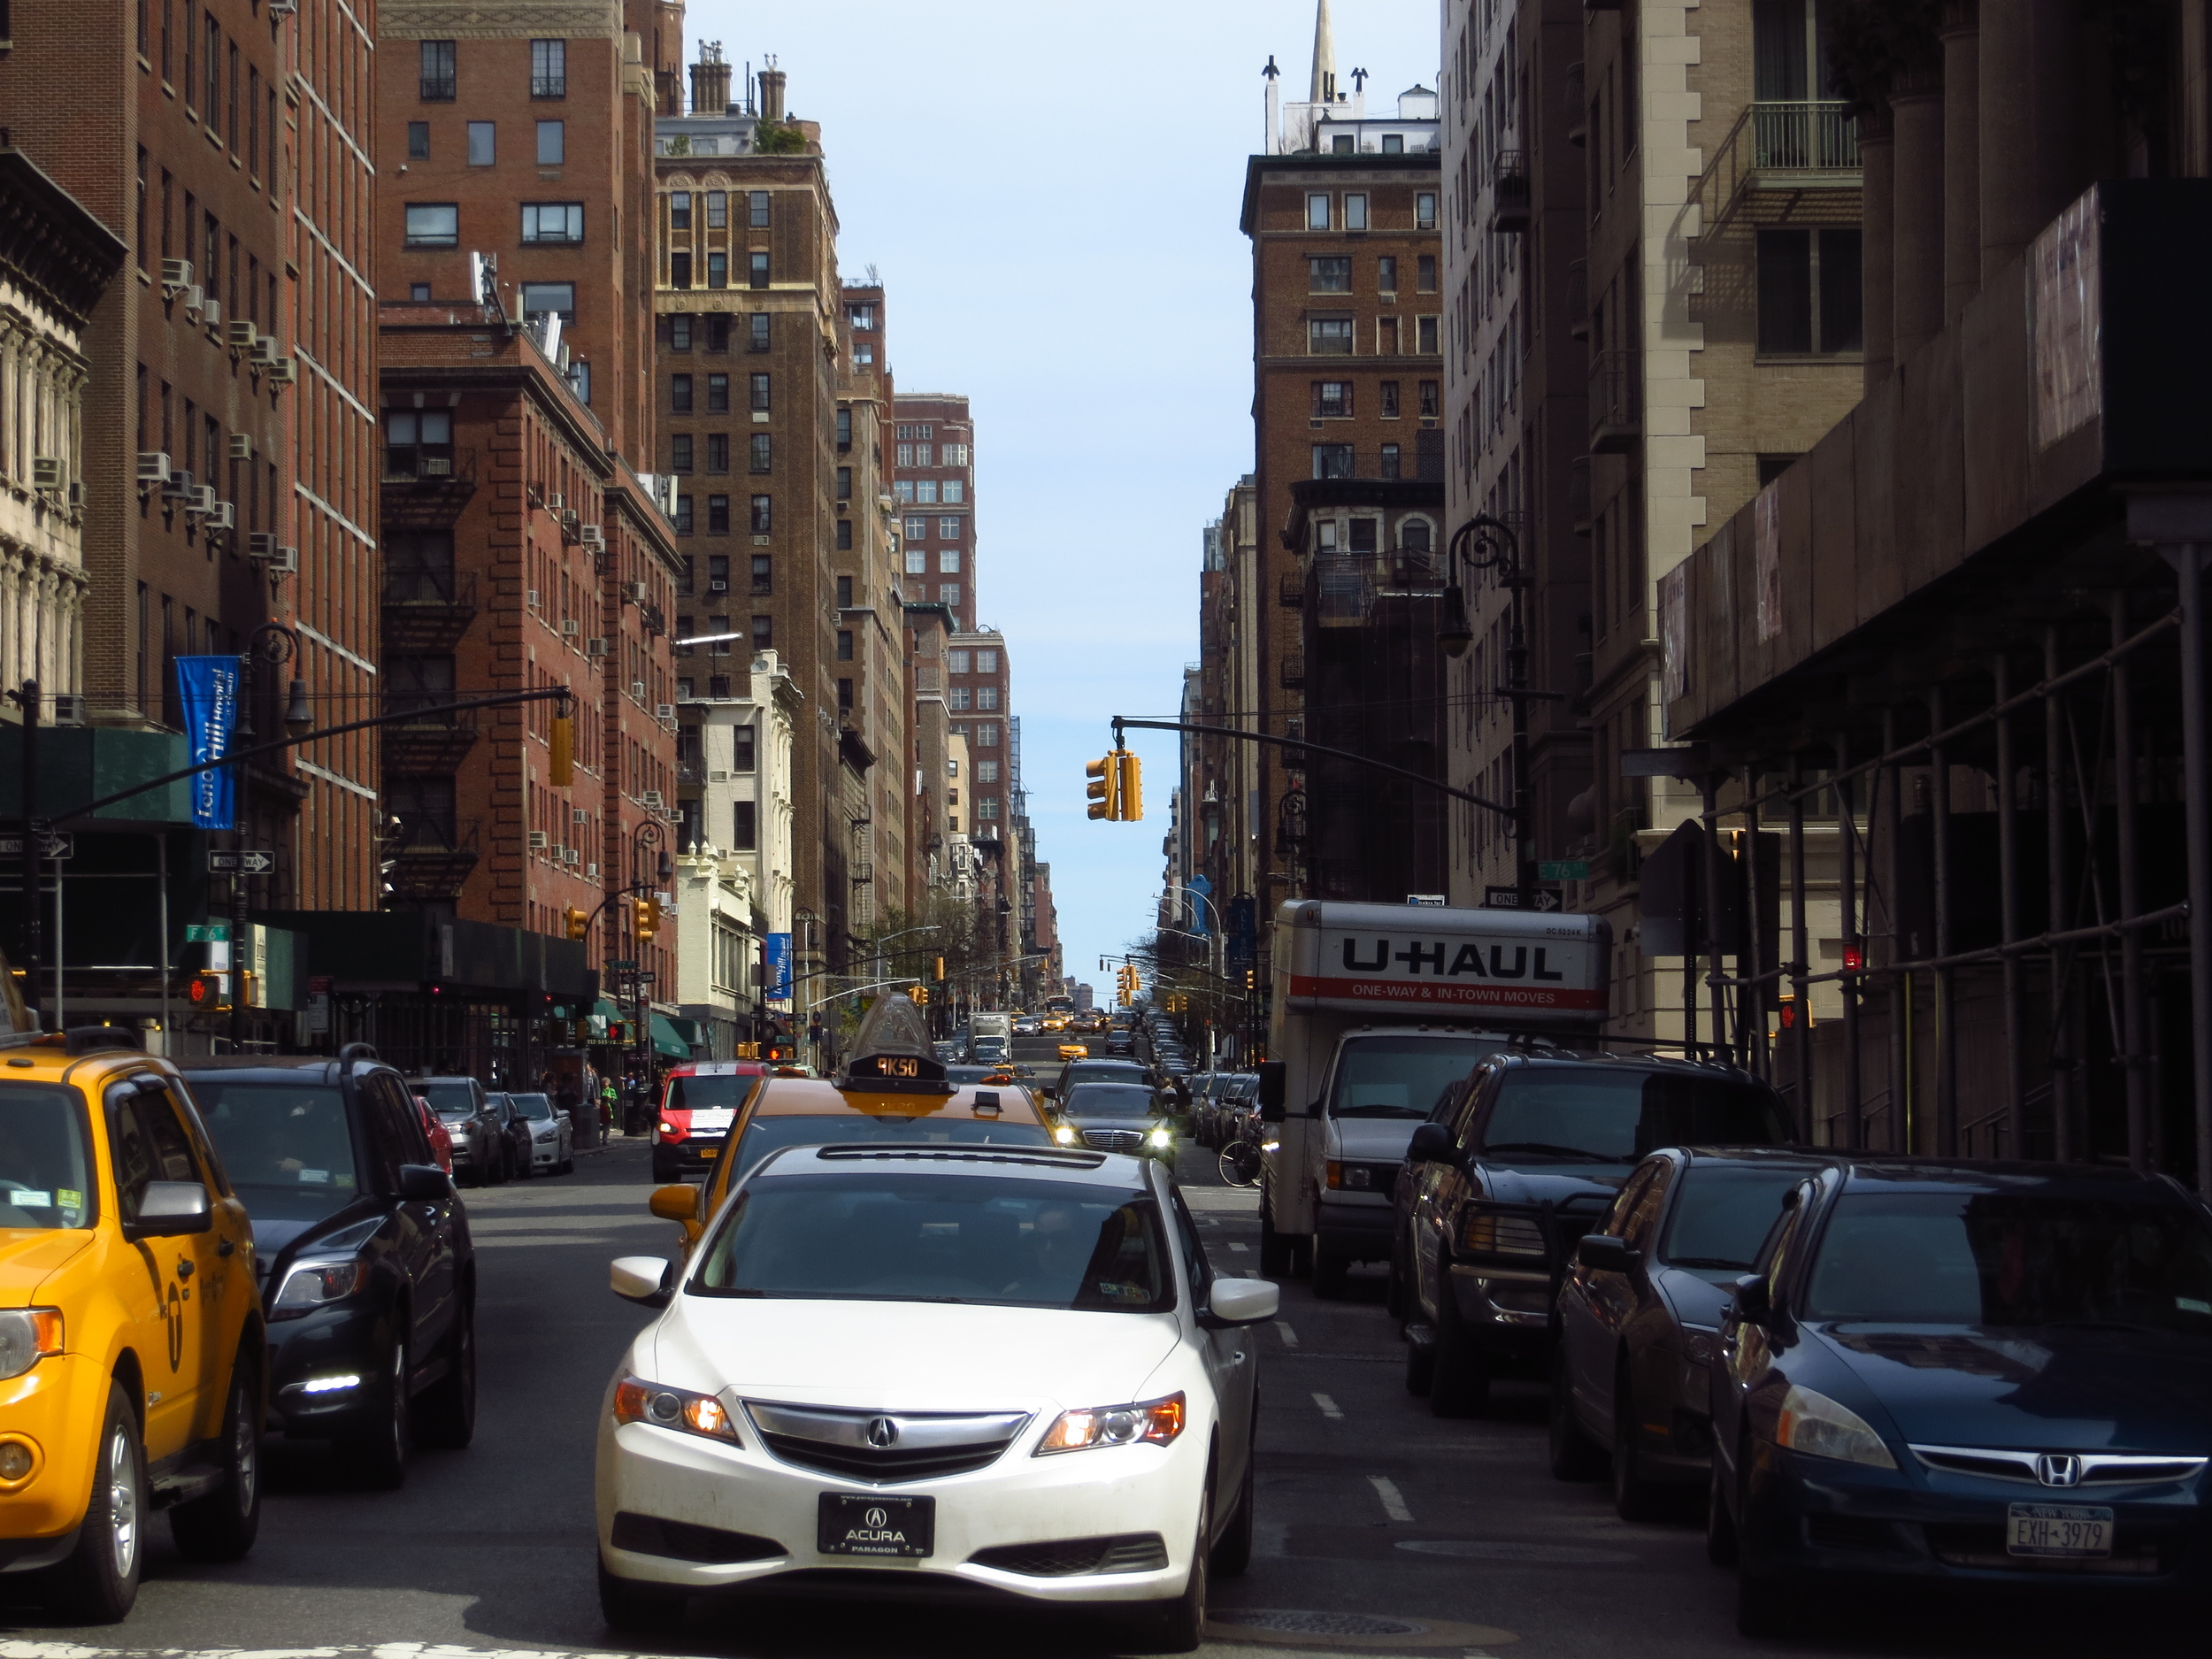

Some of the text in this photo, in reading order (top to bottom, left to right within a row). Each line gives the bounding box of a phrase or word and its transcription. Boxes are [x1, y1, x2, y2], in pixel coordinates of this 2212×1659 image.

[211, 667, 226, 722] Hospital
[204, 721, 226, 761] Hill
[6, 841, 24, 851] ON
[218, 857, 265, 867] ONE WAY
[1552, 864, 1571, 878] 76
[1496, 895, 1518, 904] ONE
[1352, 984, 1555, 1004] ONE-WAY & IN-TOWN MOVES
[877, 1057, 918, 1078] 9K50
[2035, 1507, 2088, 1521] NEW YORK
[845, 1529, 906, 1543] ACURA
[851, 1545, 899, 1555] PARAGON
